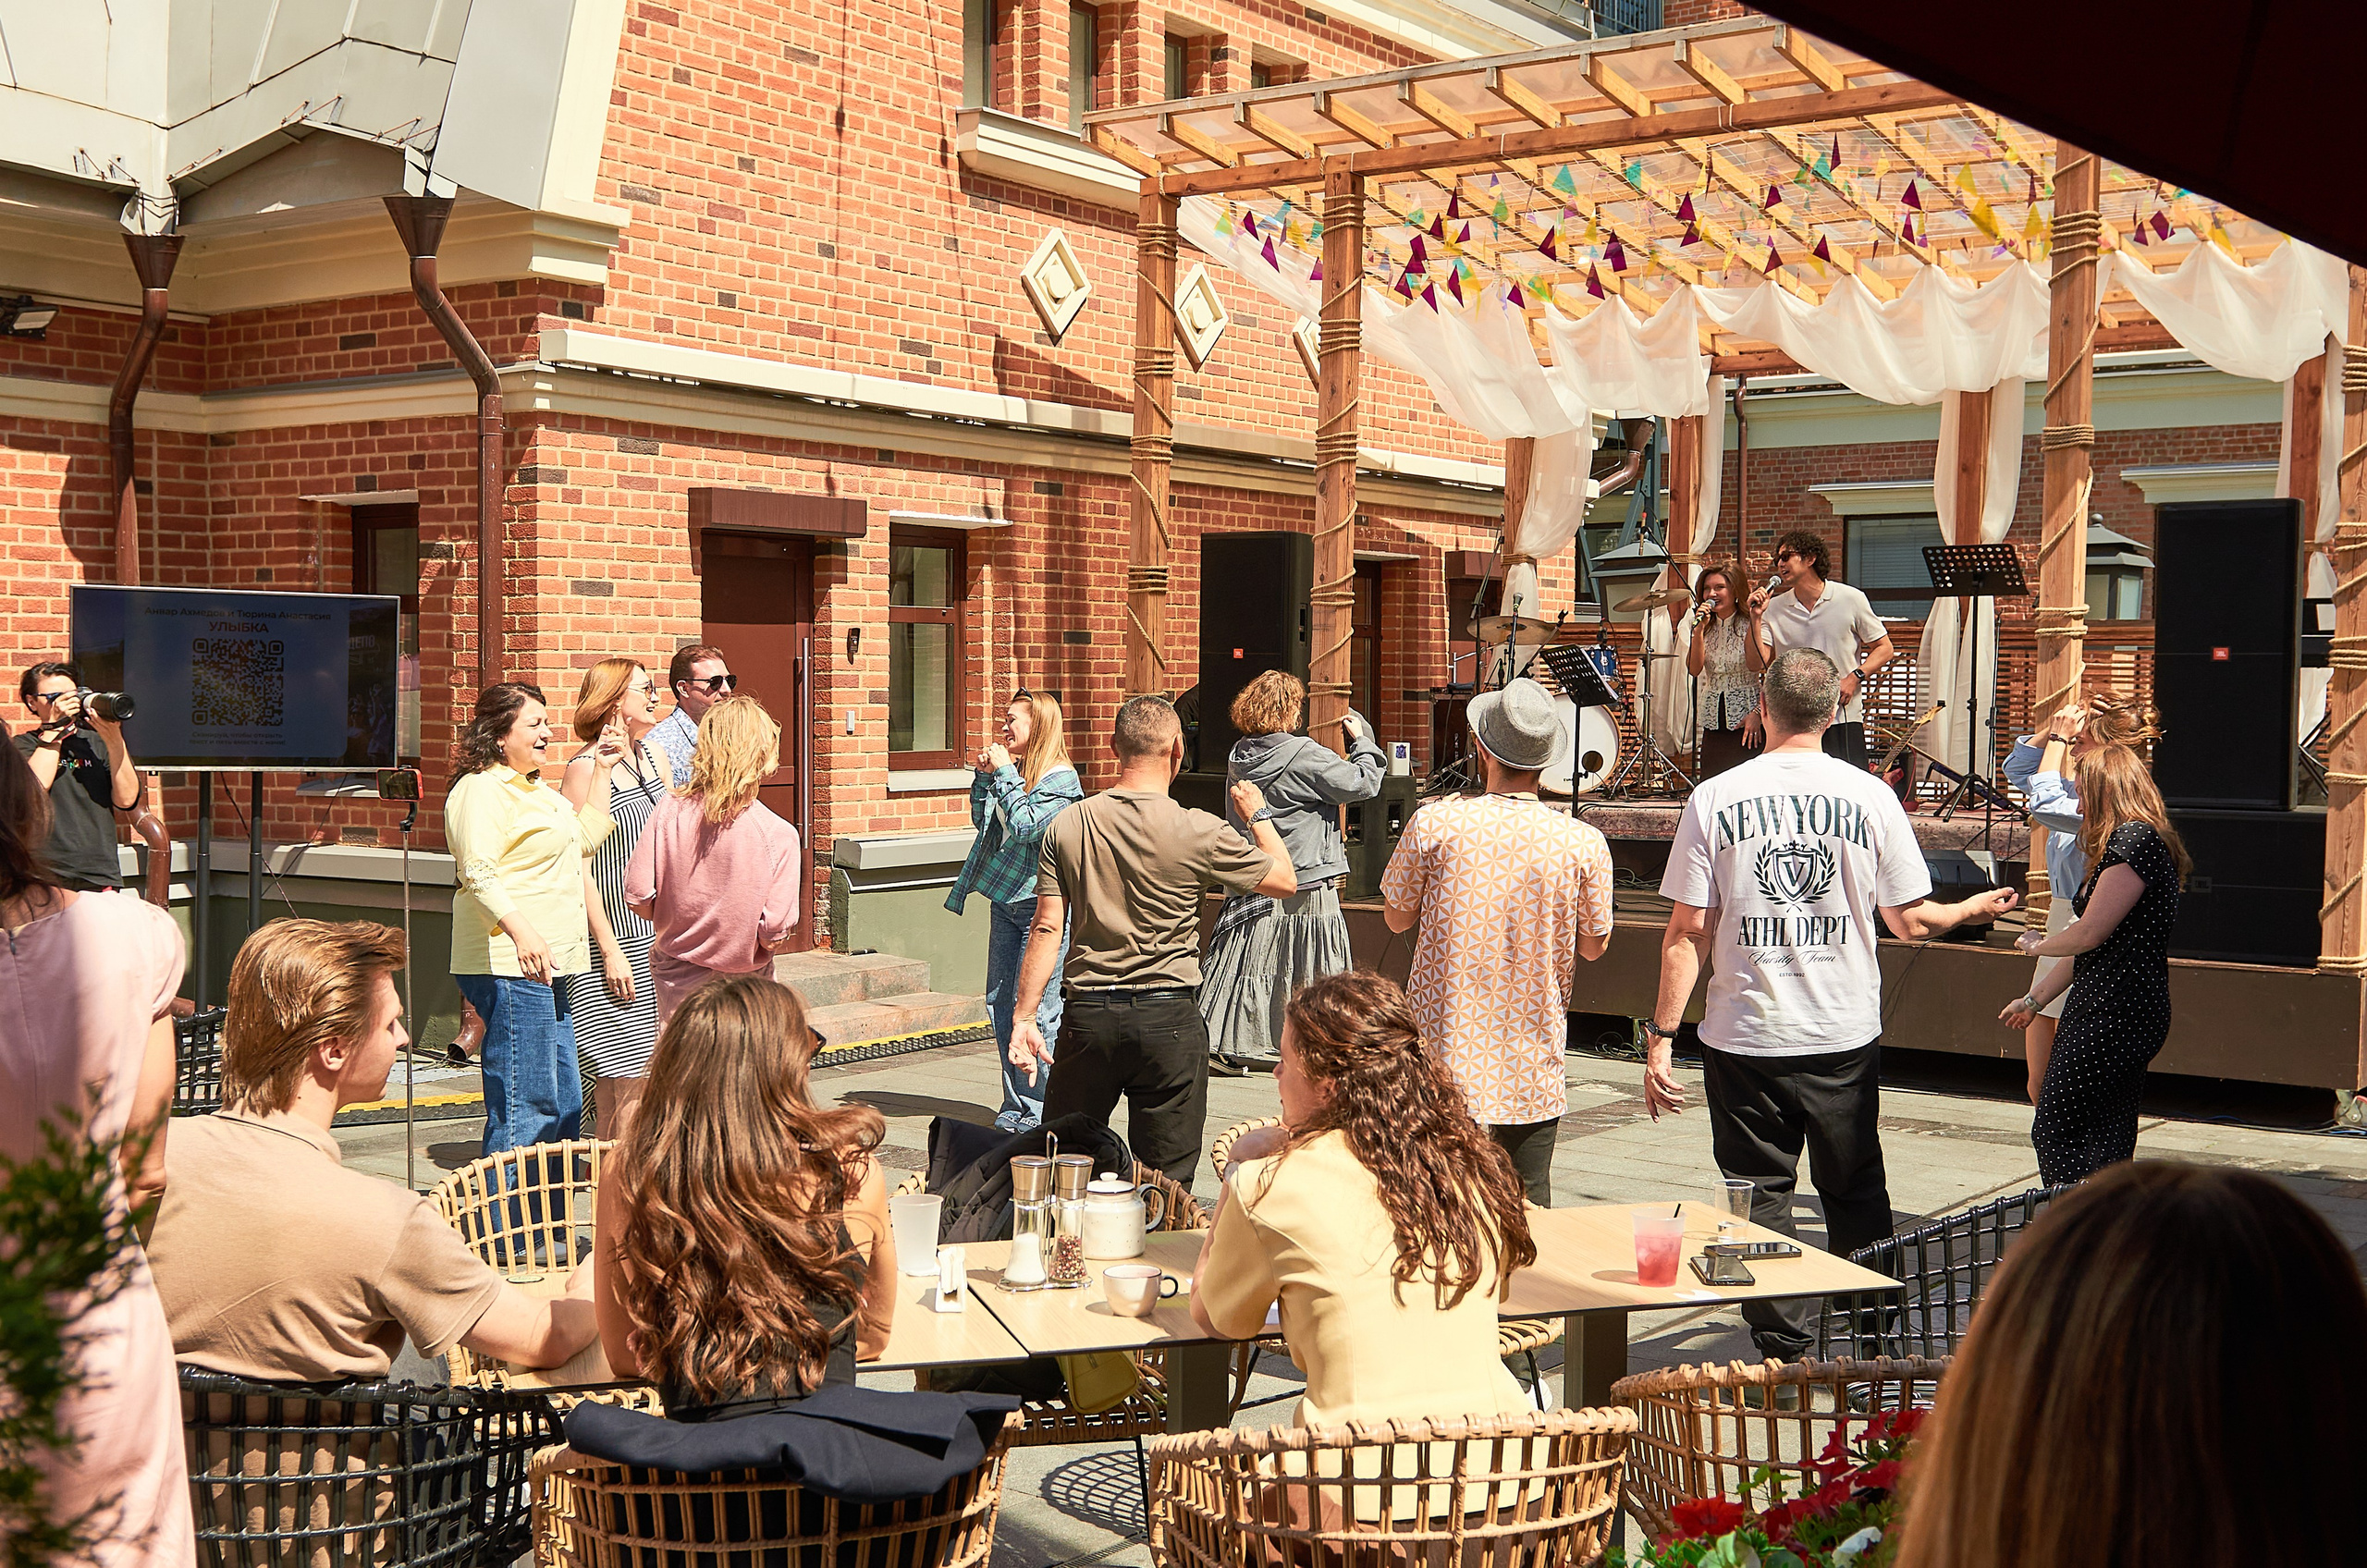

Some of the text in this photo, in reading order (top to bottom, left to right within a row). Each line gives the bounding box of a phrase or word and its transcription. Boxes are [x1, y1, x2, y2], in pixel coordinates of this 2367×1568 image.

[144, 606, 178, 617] Анвар
[180, 607, 225, 618] Ахмедов
[237, 609, 276, 619] Тюрина
[278, 611, 331, 620] Анастасия
[209, 621, 269, 633] УЛЫБКА
[348, 634, 375, 650] ДЕПО
[1716, 793, 1870, 852] NEW YORK
[1782, 861, 1805, 887] V
[1736, 914, 1850, 947] ATHL DEPT
[1748, 948, 1836, 968] Varsity Team
